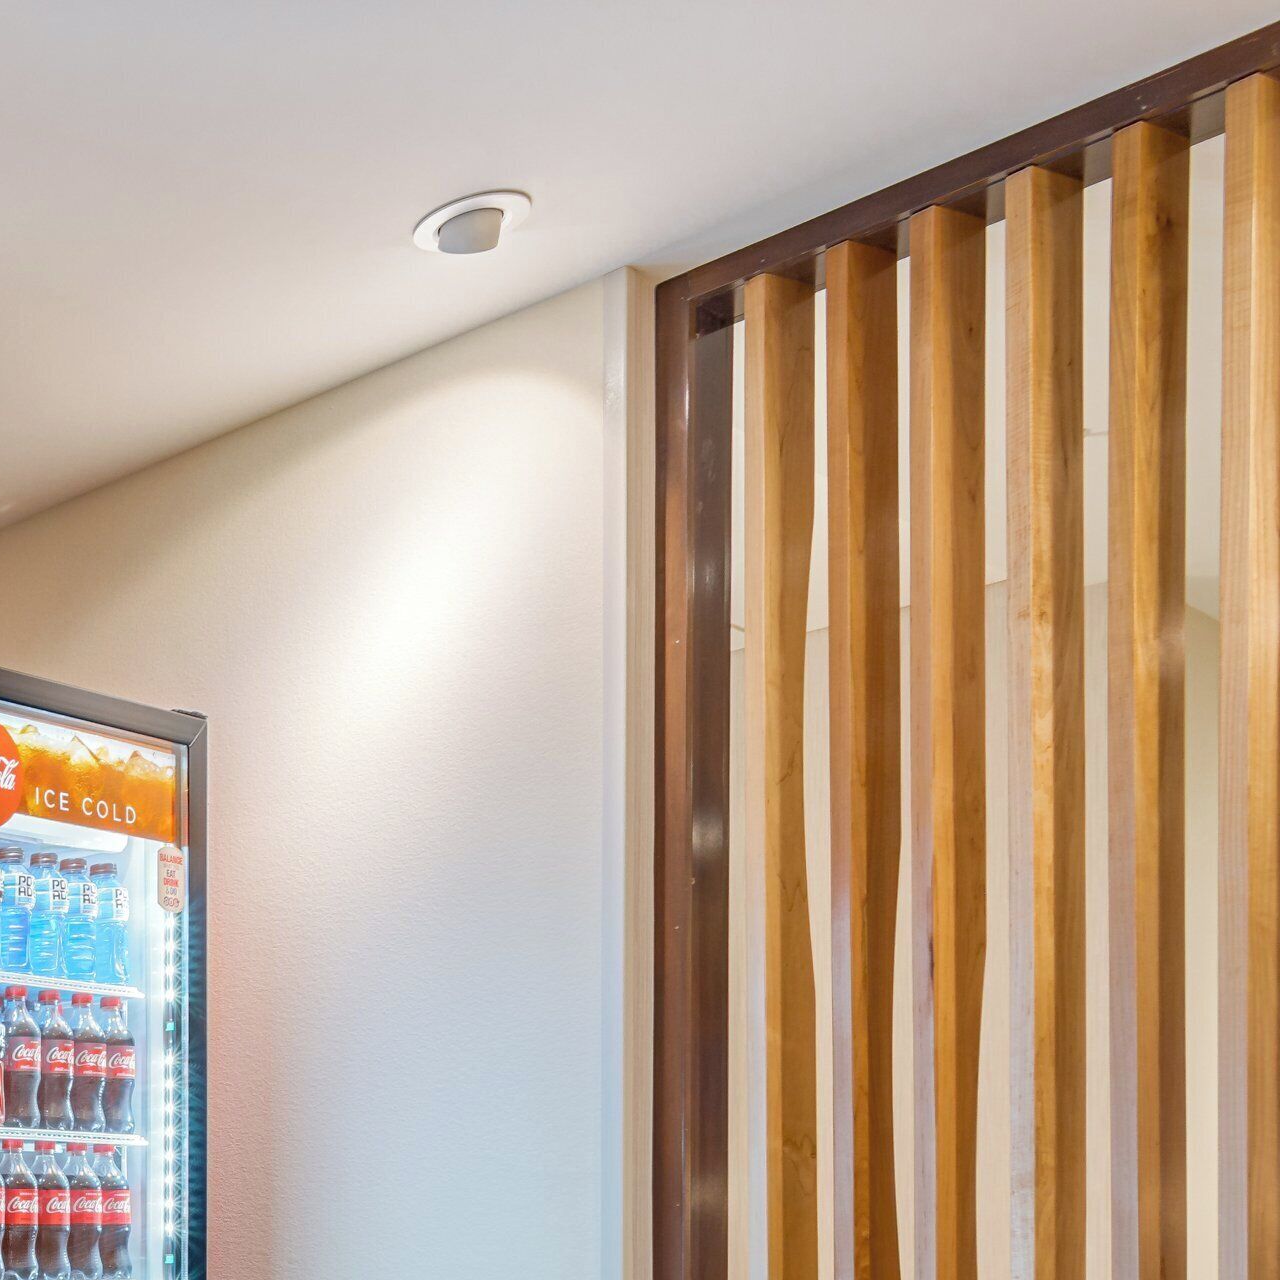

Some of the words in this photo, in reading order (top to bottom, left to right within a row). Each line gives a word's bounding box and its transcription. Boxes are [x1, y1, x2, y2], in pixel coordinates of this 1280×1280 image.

[35, 786, 69, 811] ICE
[82, 797, 137, 824] COLD
[160, 854, 183, 865] BALANCE
[167, 869, 176, 878] EAT
